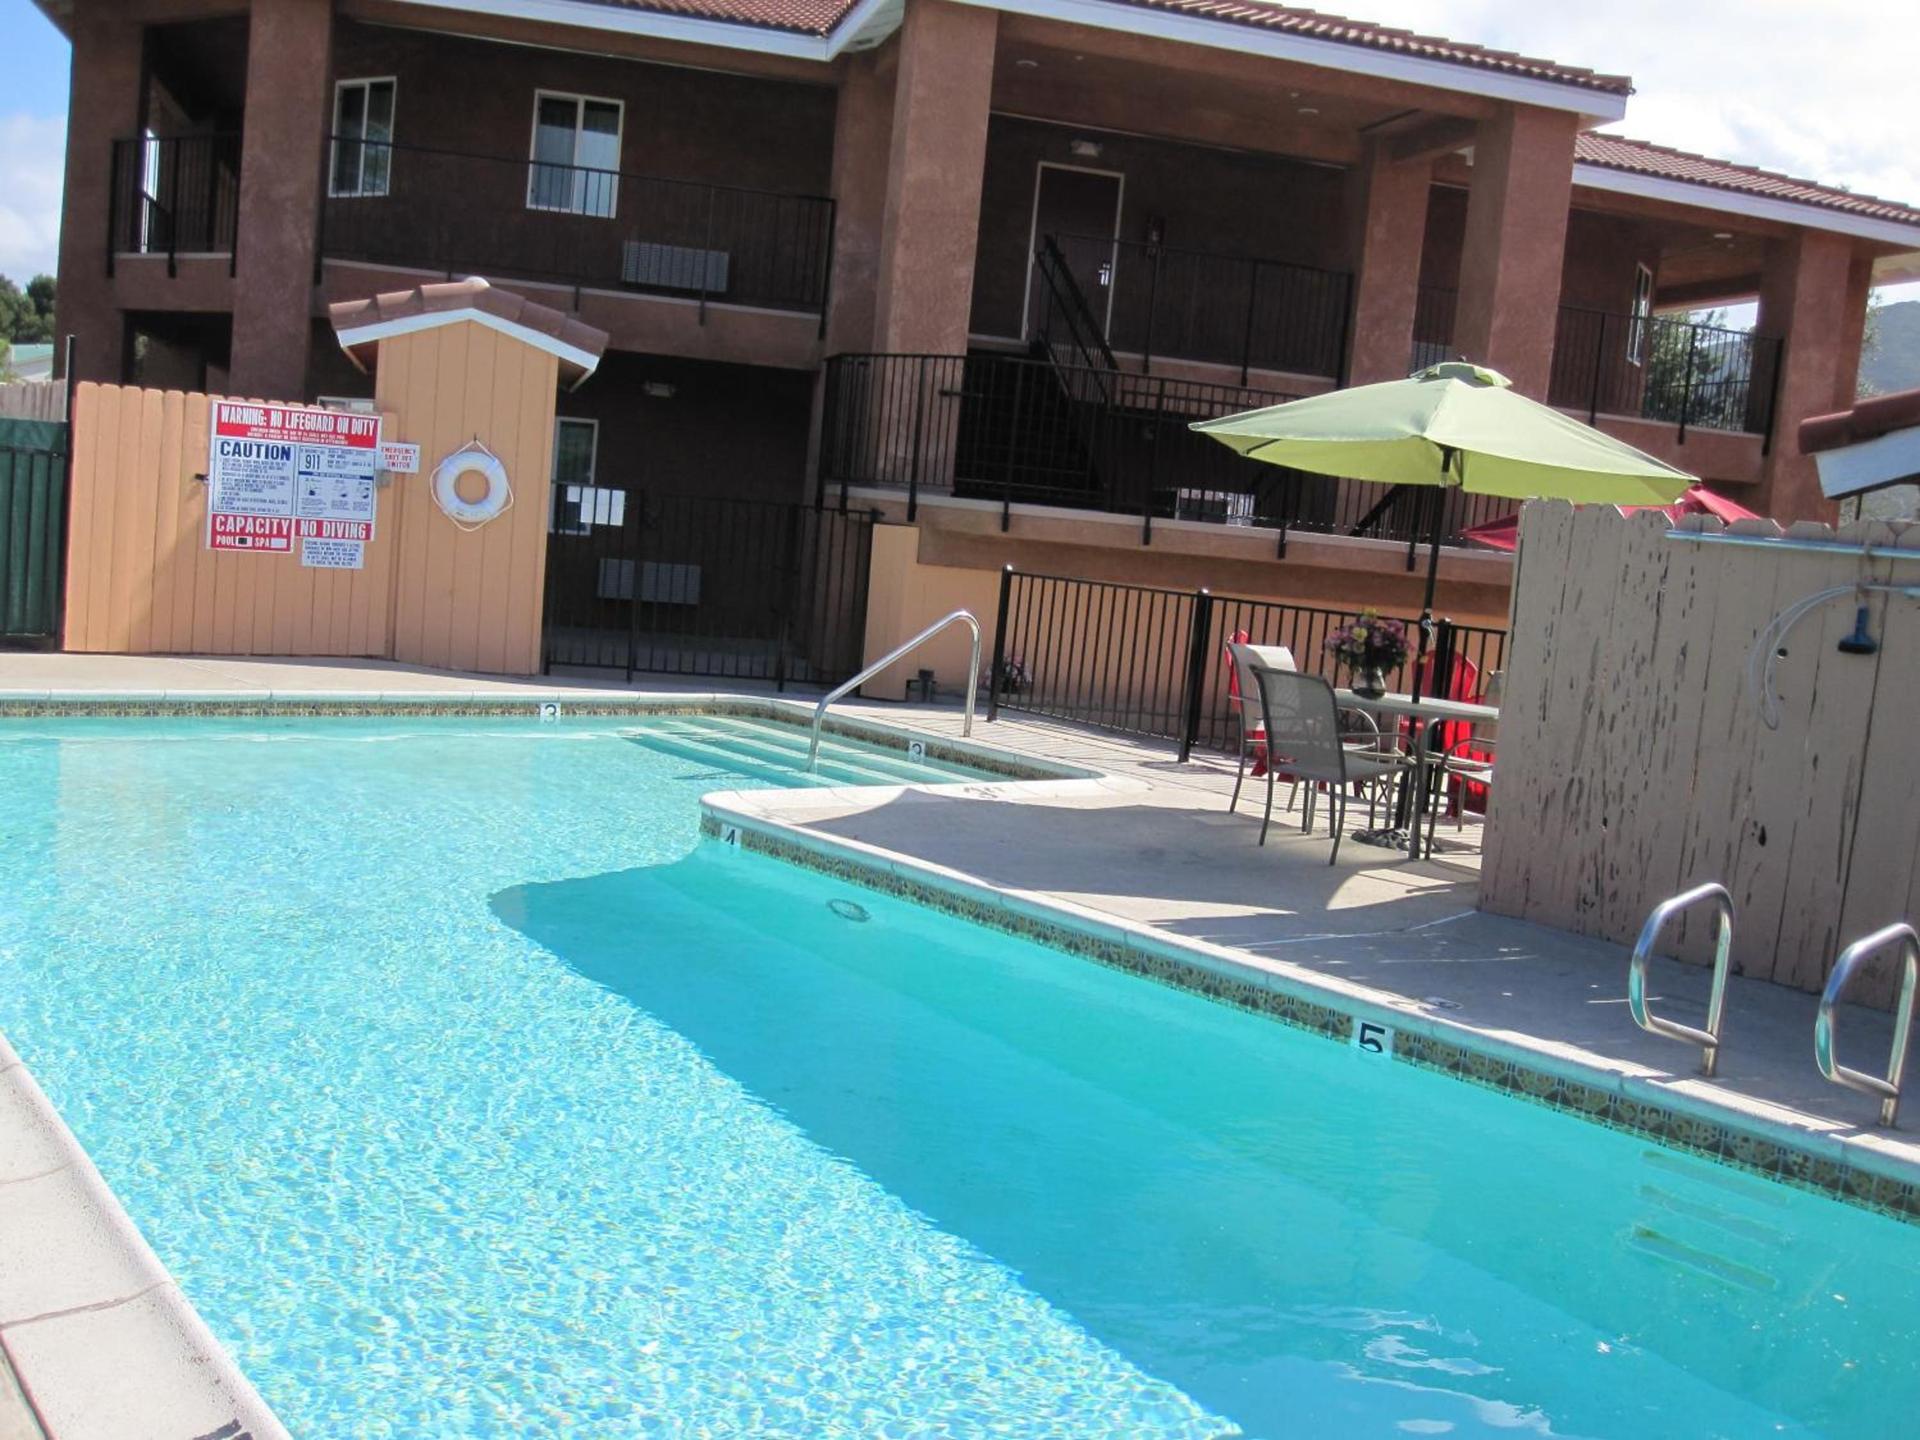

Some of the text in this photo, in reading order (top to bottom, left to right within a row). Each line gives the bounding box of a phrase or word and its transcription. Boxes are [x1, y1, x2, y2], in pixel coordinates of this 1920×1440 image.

[221, 405, 267, 426] WARNING:
[270, 409, 282, 427] NO
[285, 411, 334, 432] LIFEGUARD
[337, 416, 349, 434] ON
[351, 418, 375, 437] DUTY
[220, 440, 291, 461] CAUTION
[305, 454, 320, 470] 911
[215, 515, 290, 535] CAPACITY
[300, 520, 367, 539] NO DIVING
[216, 535, 236, 546] POOL
[254, 537, 270, 548] SPA
[1359, 1022, 1386, 1053] 5
